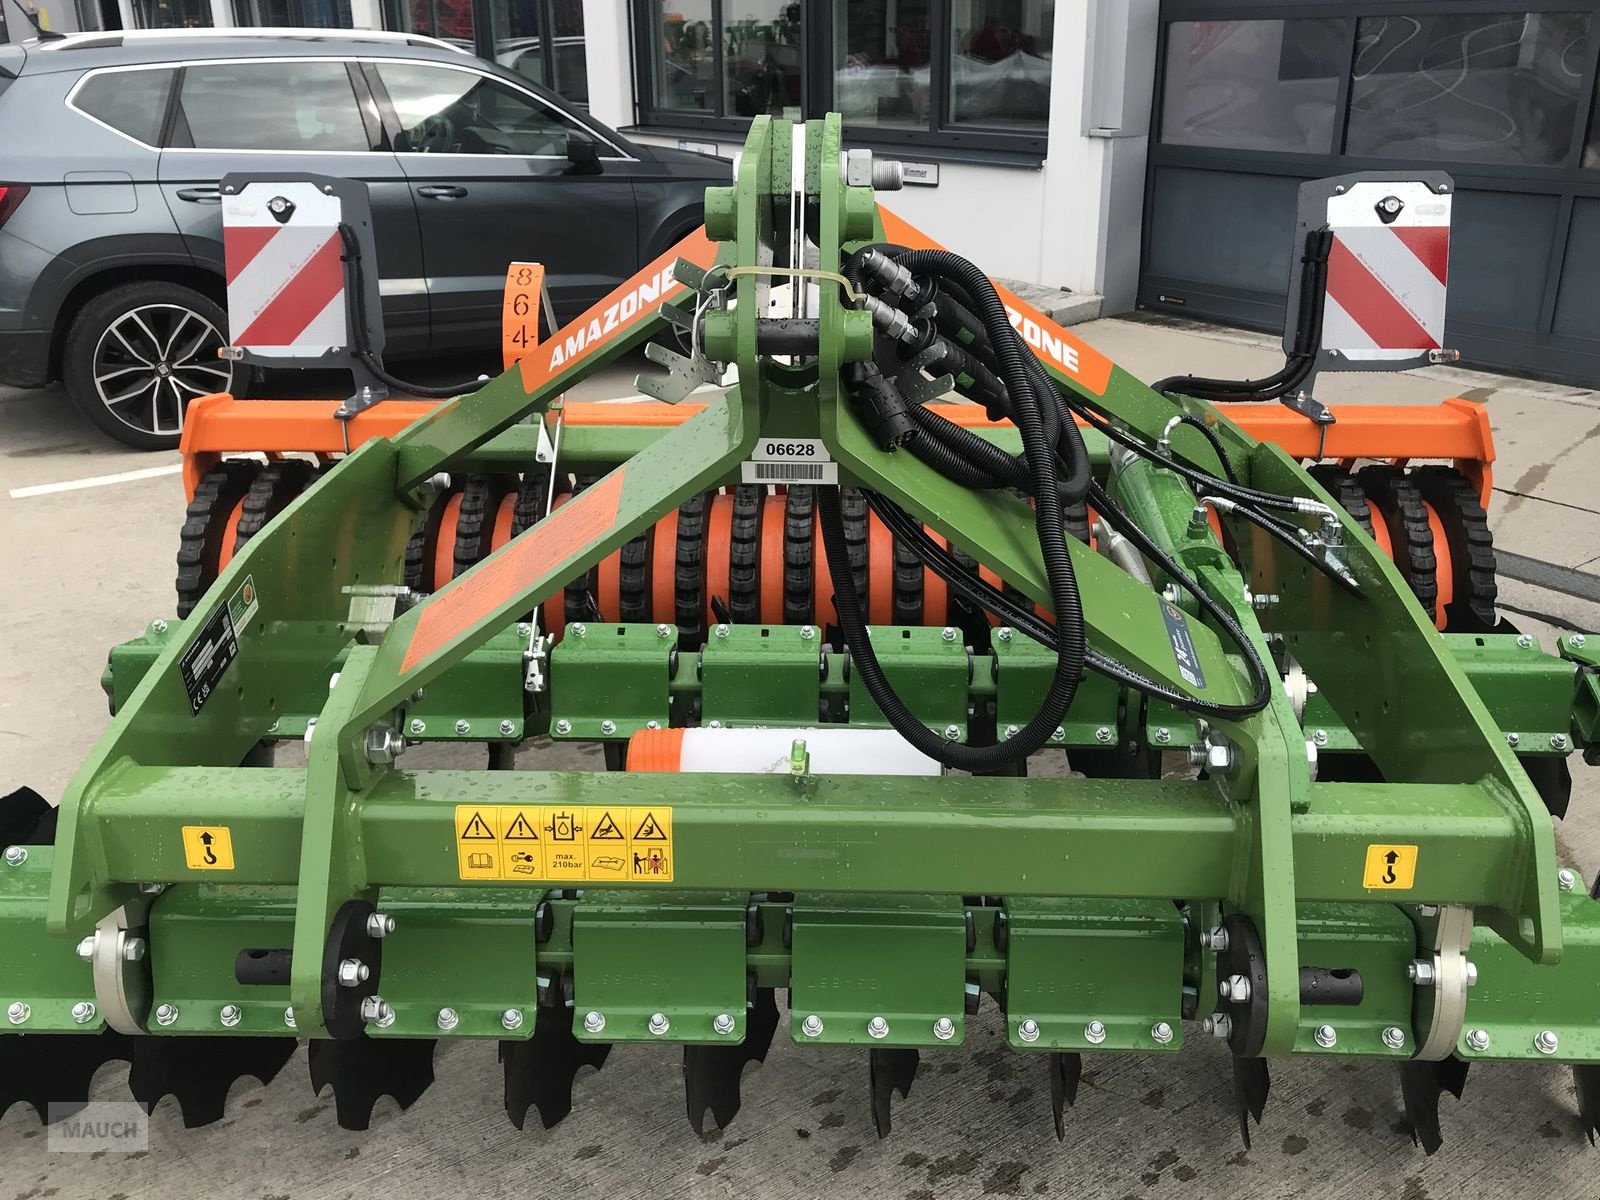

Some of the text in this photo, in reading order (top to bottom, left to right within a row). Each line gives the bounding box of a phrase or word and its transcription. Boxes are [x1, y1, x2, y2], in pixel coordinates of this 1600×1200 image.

[516, 268, 532, 286] 8
[513, 293, 529, 316] 6
[549, 261, 679, 372] AMAZONE
[512, 324, 529, 348] 4
[1004, 304, 1079, 374] ZONE
[766, 443, 815, 456] 06628
